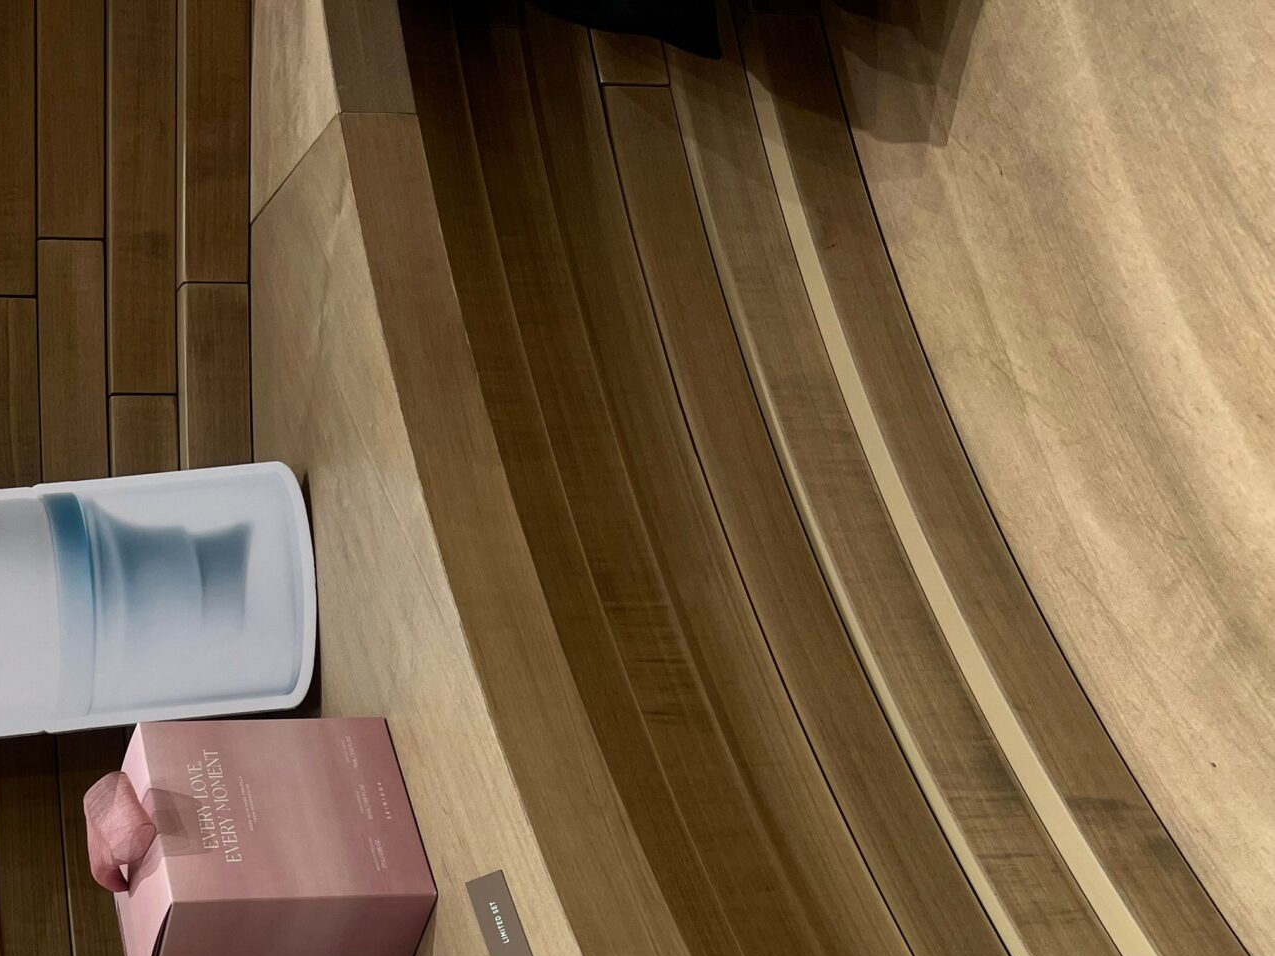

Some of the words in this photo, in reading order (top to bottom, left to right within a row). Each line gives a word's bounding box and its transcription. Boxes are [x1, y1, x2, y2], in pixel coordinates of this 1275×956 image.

[203, 748, 232, 811] MOMENT
[196, 804, 220, 849] EVERY
[218, 815, 242, 863] EVERY
[489, 901, 499, 914] SET
[494, 915, 510, 944] LIMITED
